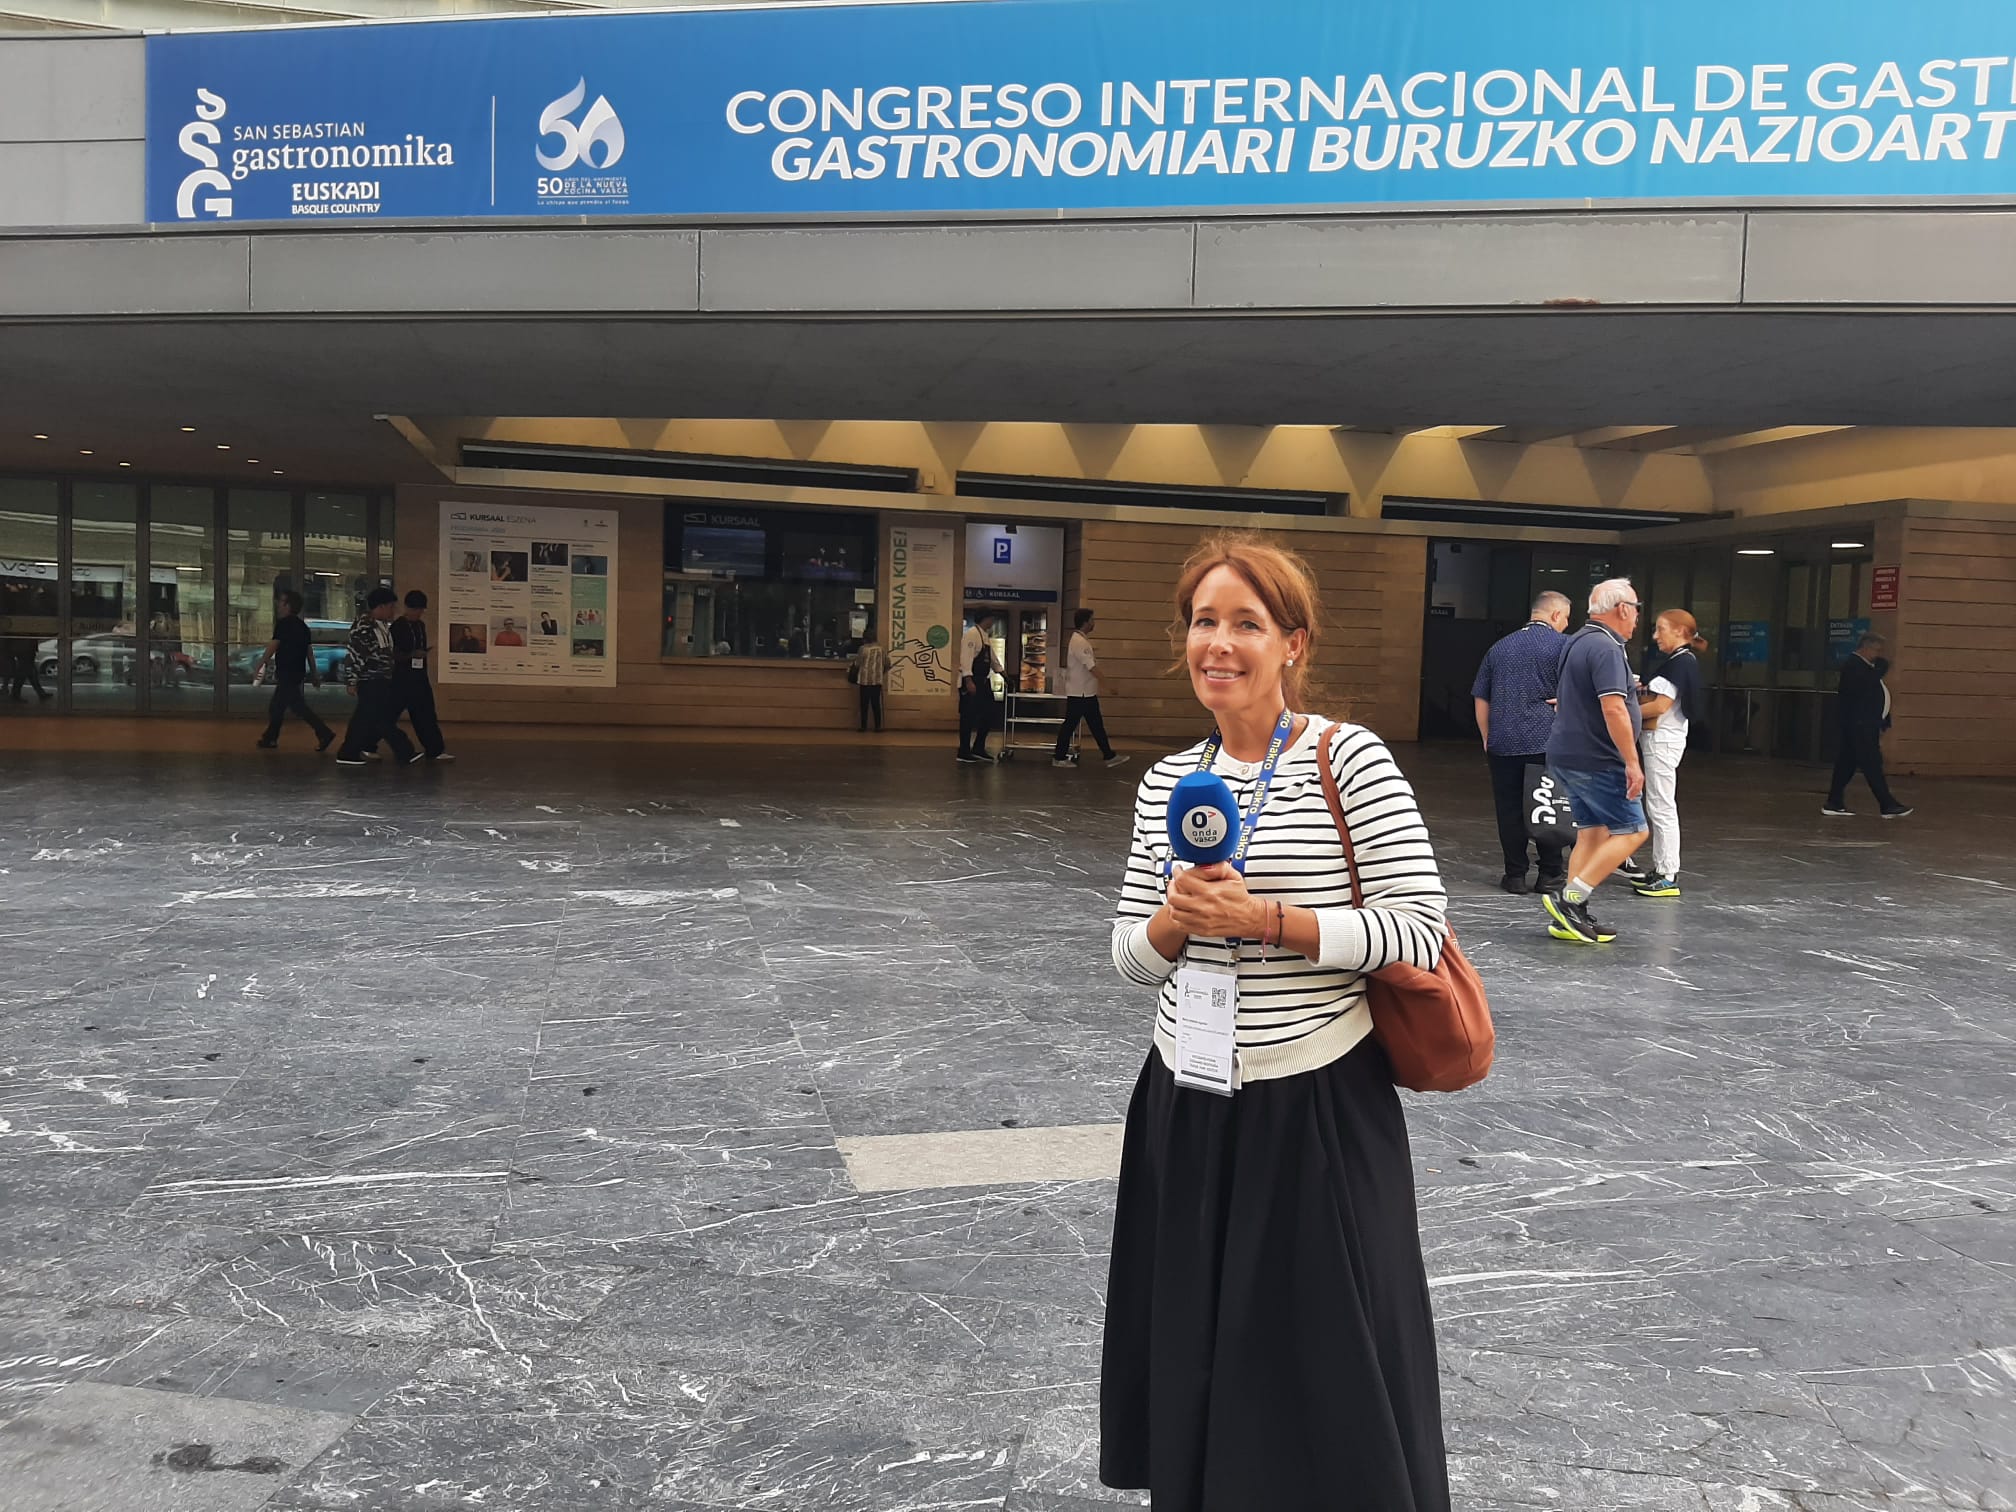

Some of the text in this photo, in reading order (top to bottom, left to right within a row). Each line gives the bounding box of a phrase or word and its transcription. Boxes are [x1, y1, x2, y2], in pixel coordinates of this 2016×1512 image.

[726, 83, 1082, 135] CONGRESO
[1101, 67, 1676, 127] INTERNACIONAL
[1695, 63, 1790, 112] DE
[233, 122, 365, 142] SAN SEBASTIAN
[232, 133, 455, 181] gastronomika
[771, 128, 1296, 182] GASTRONOMIARI
[1308, 118, 1638, 173] BURUZKO
[291, 181, 381, 202] EUSKADI
[537, 177, 564, 195] 50
[564, 187, 597, 195] COCINA
[291, 202, 381, 216] BASQUE COUNTRY
[469, 514, 505, 523] KURSAAL
[711, 513, 761, 528] KURSAAL
[892, 531, 908, 578] KIDE!
[996, 542, 1009, 559] P
[989, 591, 1021, 599] KURSAAL
[891, 583, 907, 651] ESZENA
[1264, 738, 1282, 770] makro
[1249, 781, 1267, 814] makro
[1192, 829, 1218, 837] onda
[1194, 835, 1217, 843] vasca
[1234, 826, 1251, 860] makro
